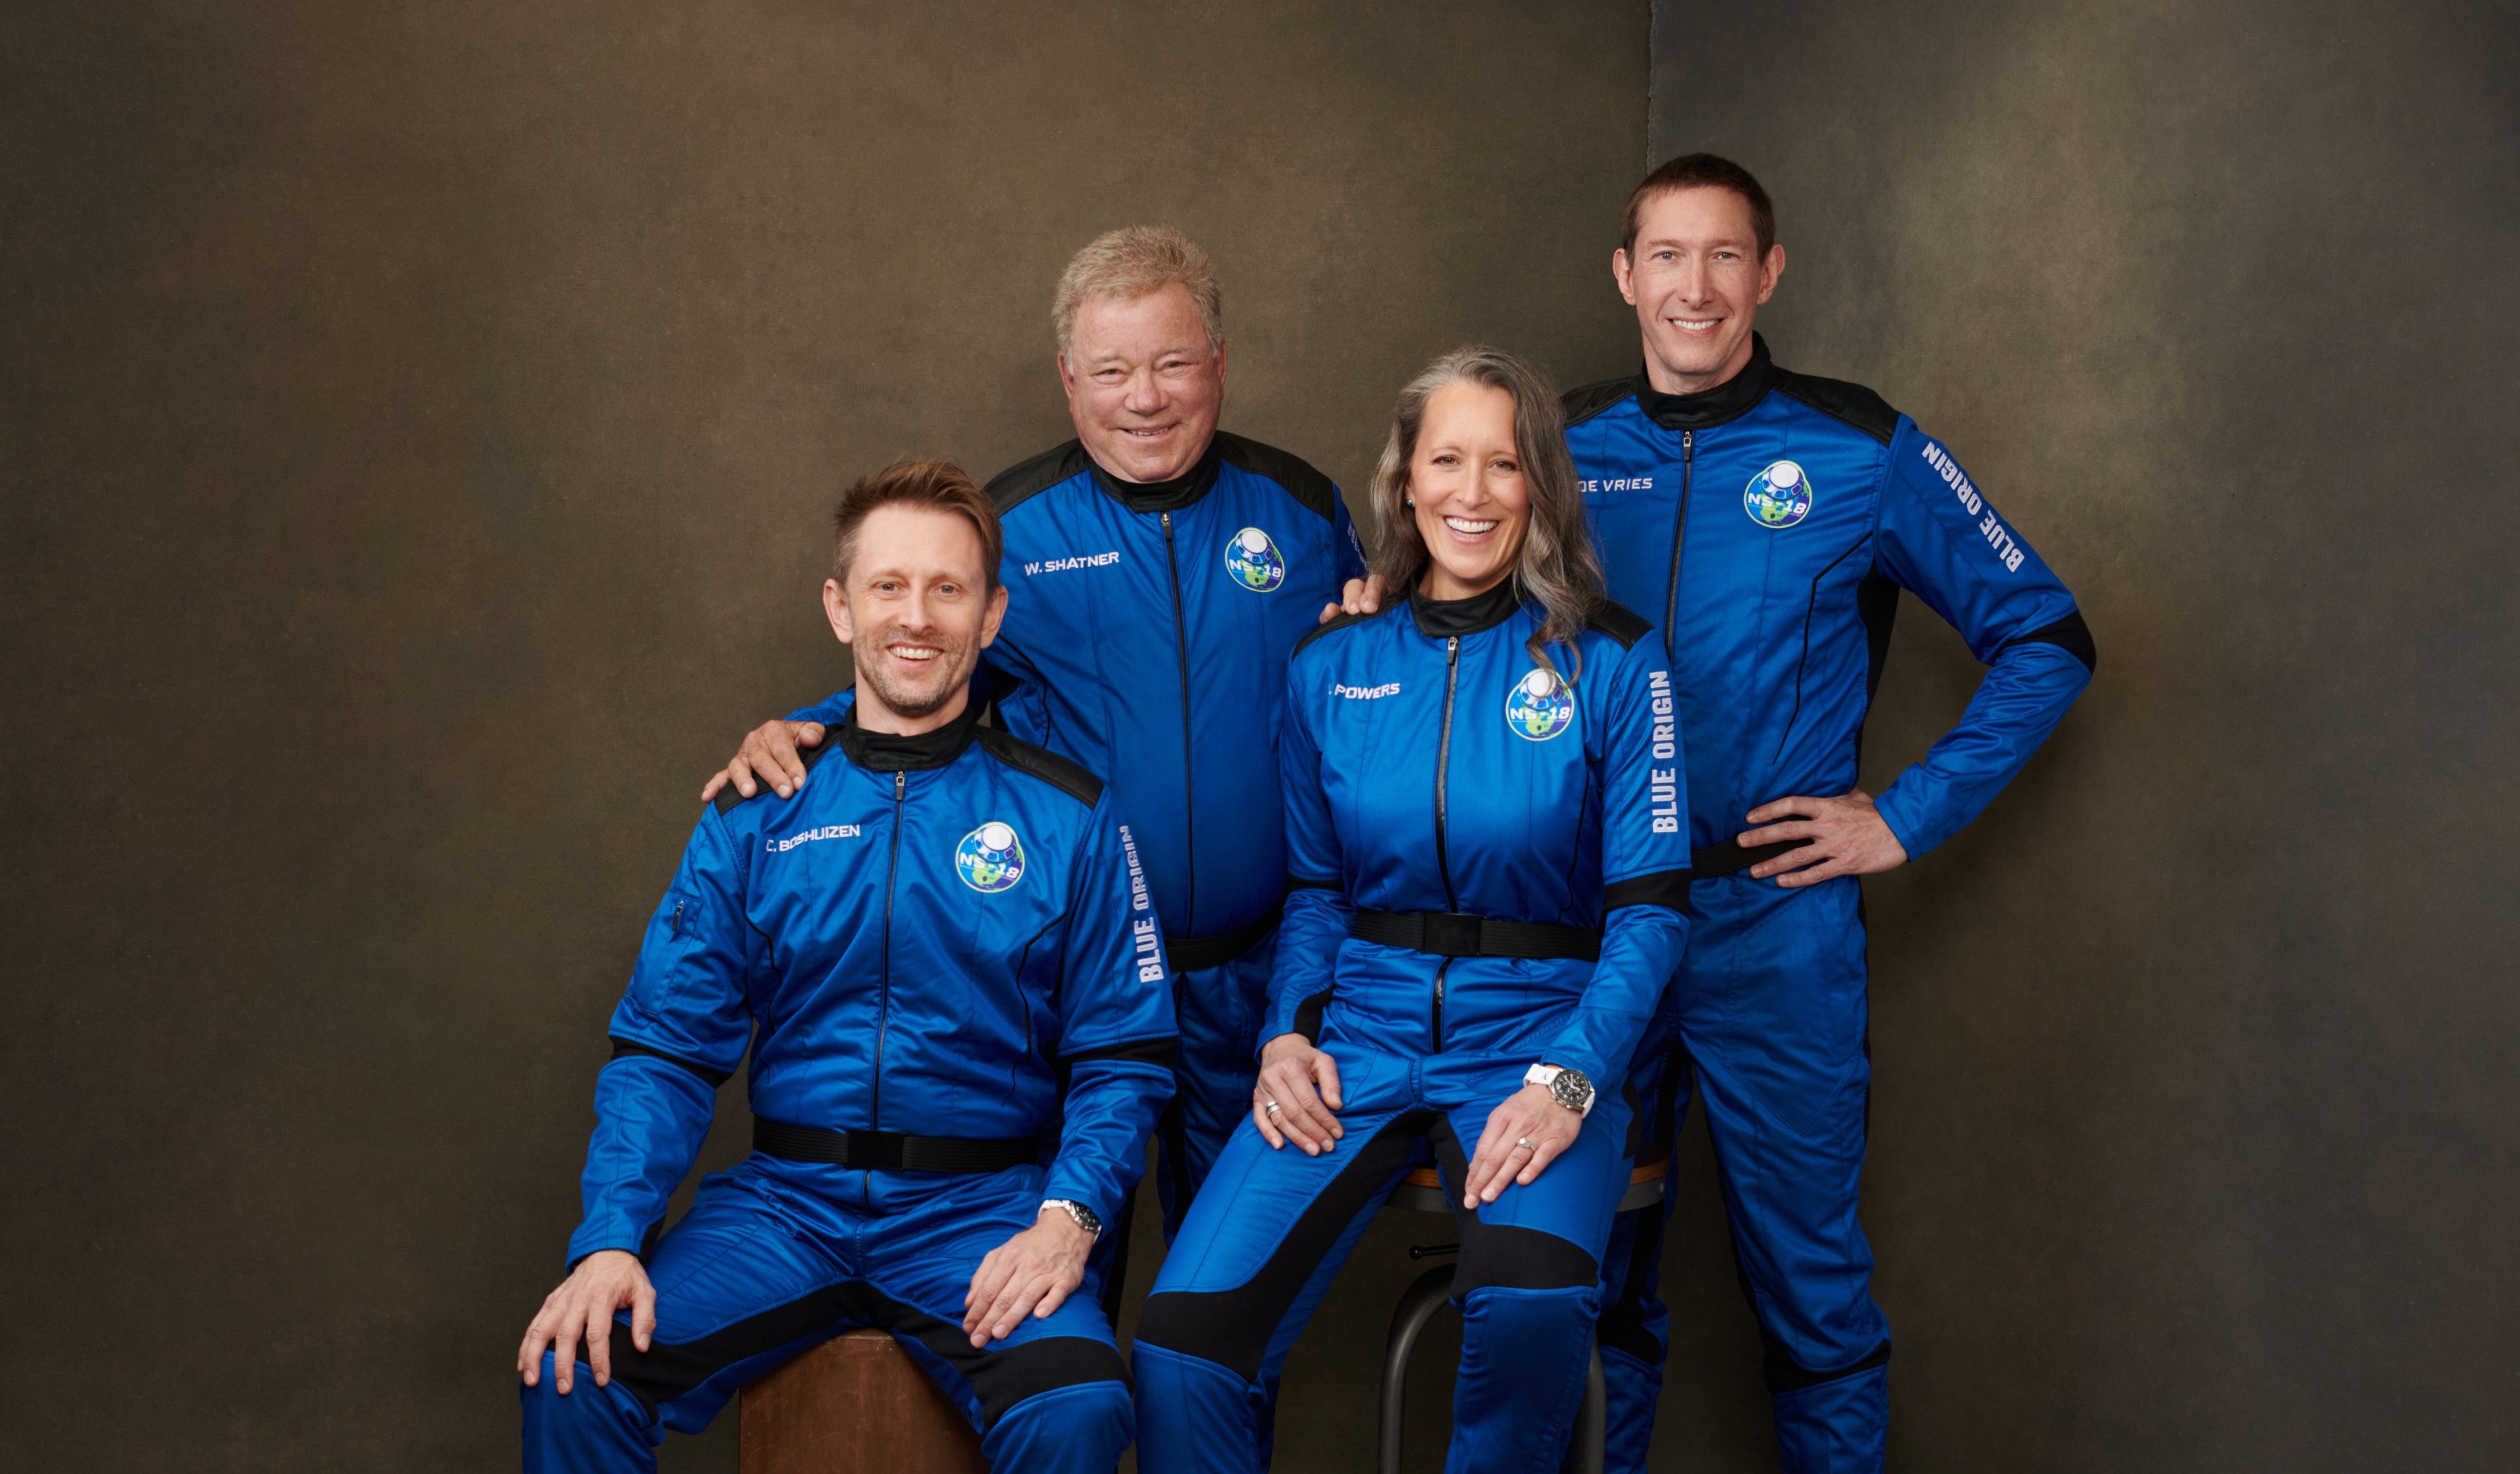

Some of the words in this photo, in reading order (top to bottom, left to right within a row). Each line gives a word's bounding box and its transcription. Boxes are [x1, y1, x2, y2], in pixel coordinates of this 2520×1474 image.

[1578, 480, 1598, 492] DE
[1603, 478, 1653, 492] VRIES
[1921, 441, 1982, 516] ORIGIN
[1748, 493, 1807, 514] NS-18
[1979, 510, 2025, 573] BLUE
[1024, 562, 1043, 576] W.
[1045, 552, 1120, 573] SHATNER
[1229, 559, 1282, 578] NS-18
[1334, 683, 1400, 699] POWERS
[1510, 706, 1571, 720] NS-18
[1649, 671, 1675, 759] ORIGIN
[1651, 768, 1678, 834] BLUE
[766, 839, 776, 852] C.
[779, 824, 860, 852] BOSHUIZEN
[959, 851, 1020, 879] NS-18
[1119, 825, 1149, 911] ORIGIN
[1134, 917, 1164, 983] BLUE
